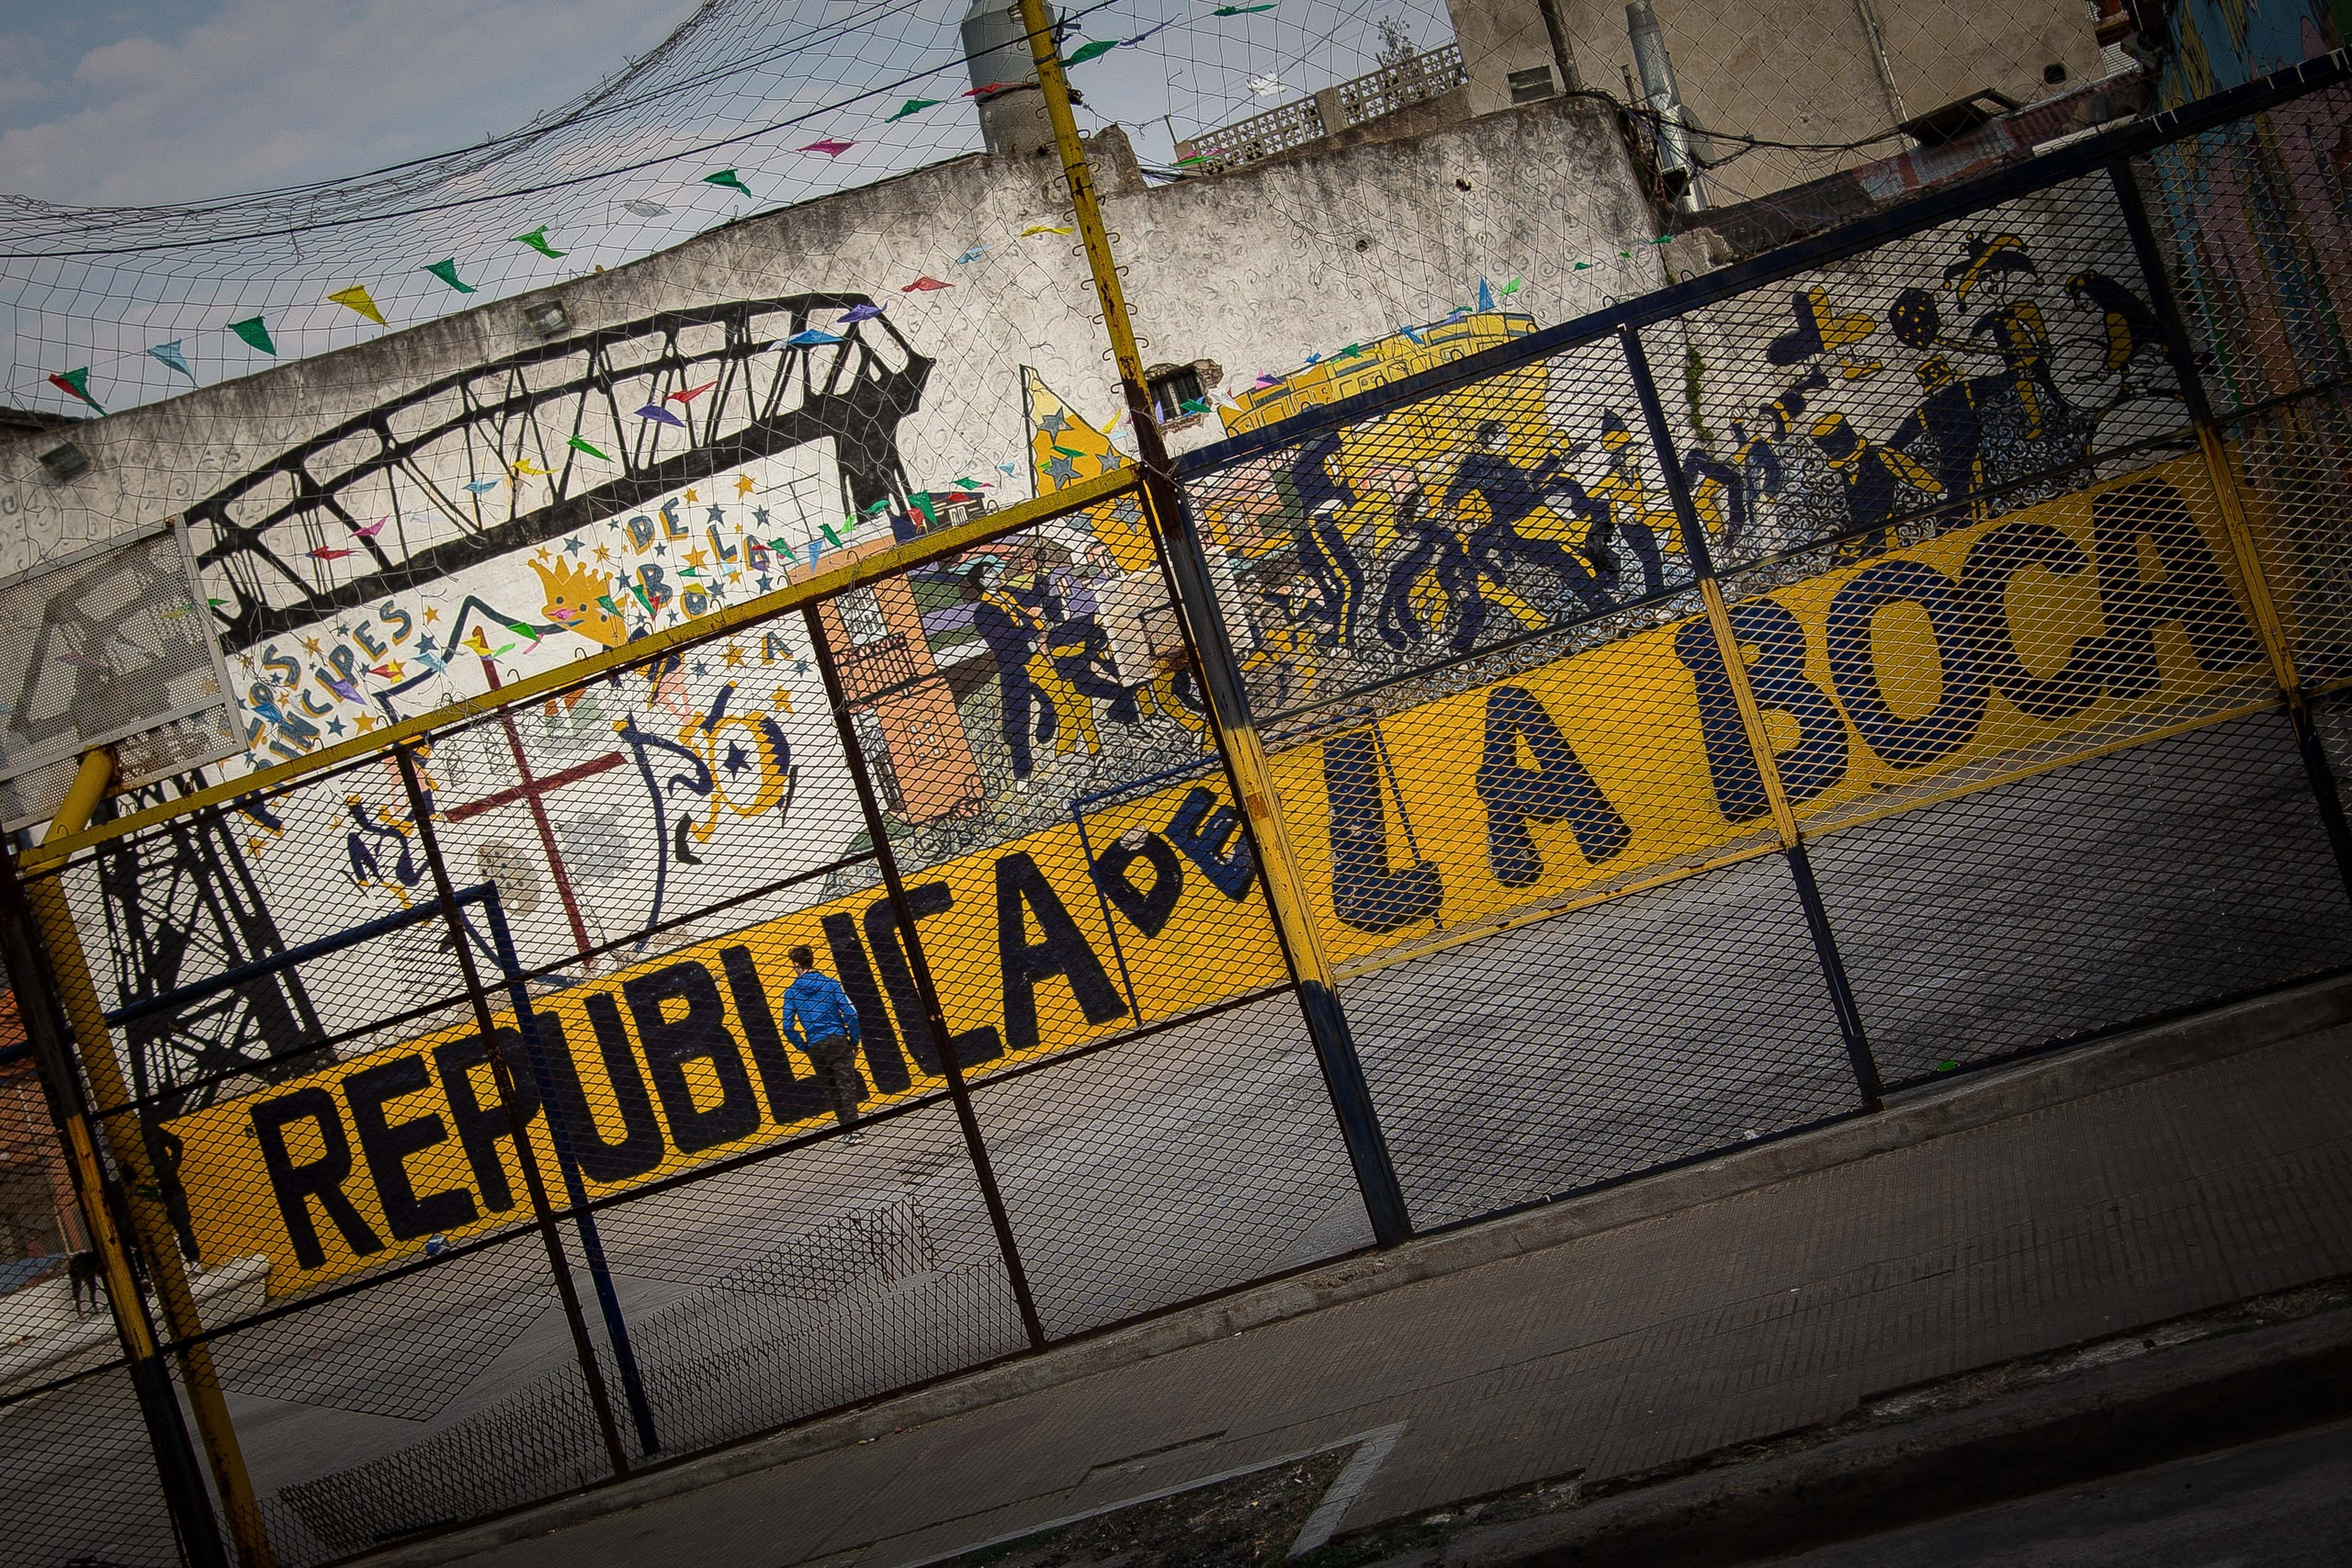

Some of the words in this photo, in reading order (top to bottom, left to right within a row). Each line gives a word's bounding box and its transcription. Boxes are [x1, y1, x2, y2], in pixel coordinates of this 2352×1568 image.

[627, 497, 689, 556] DE
[707, 524, 770, 572] LA
[636, 563, 794, 665] BOA
[250, 851, 1129, 1270] REPUBLICA
[1089, 785, 1259, 938] DE
[1323, 686, 1632, 933] LA
[1675, 477, 2267, 822] BOCA
